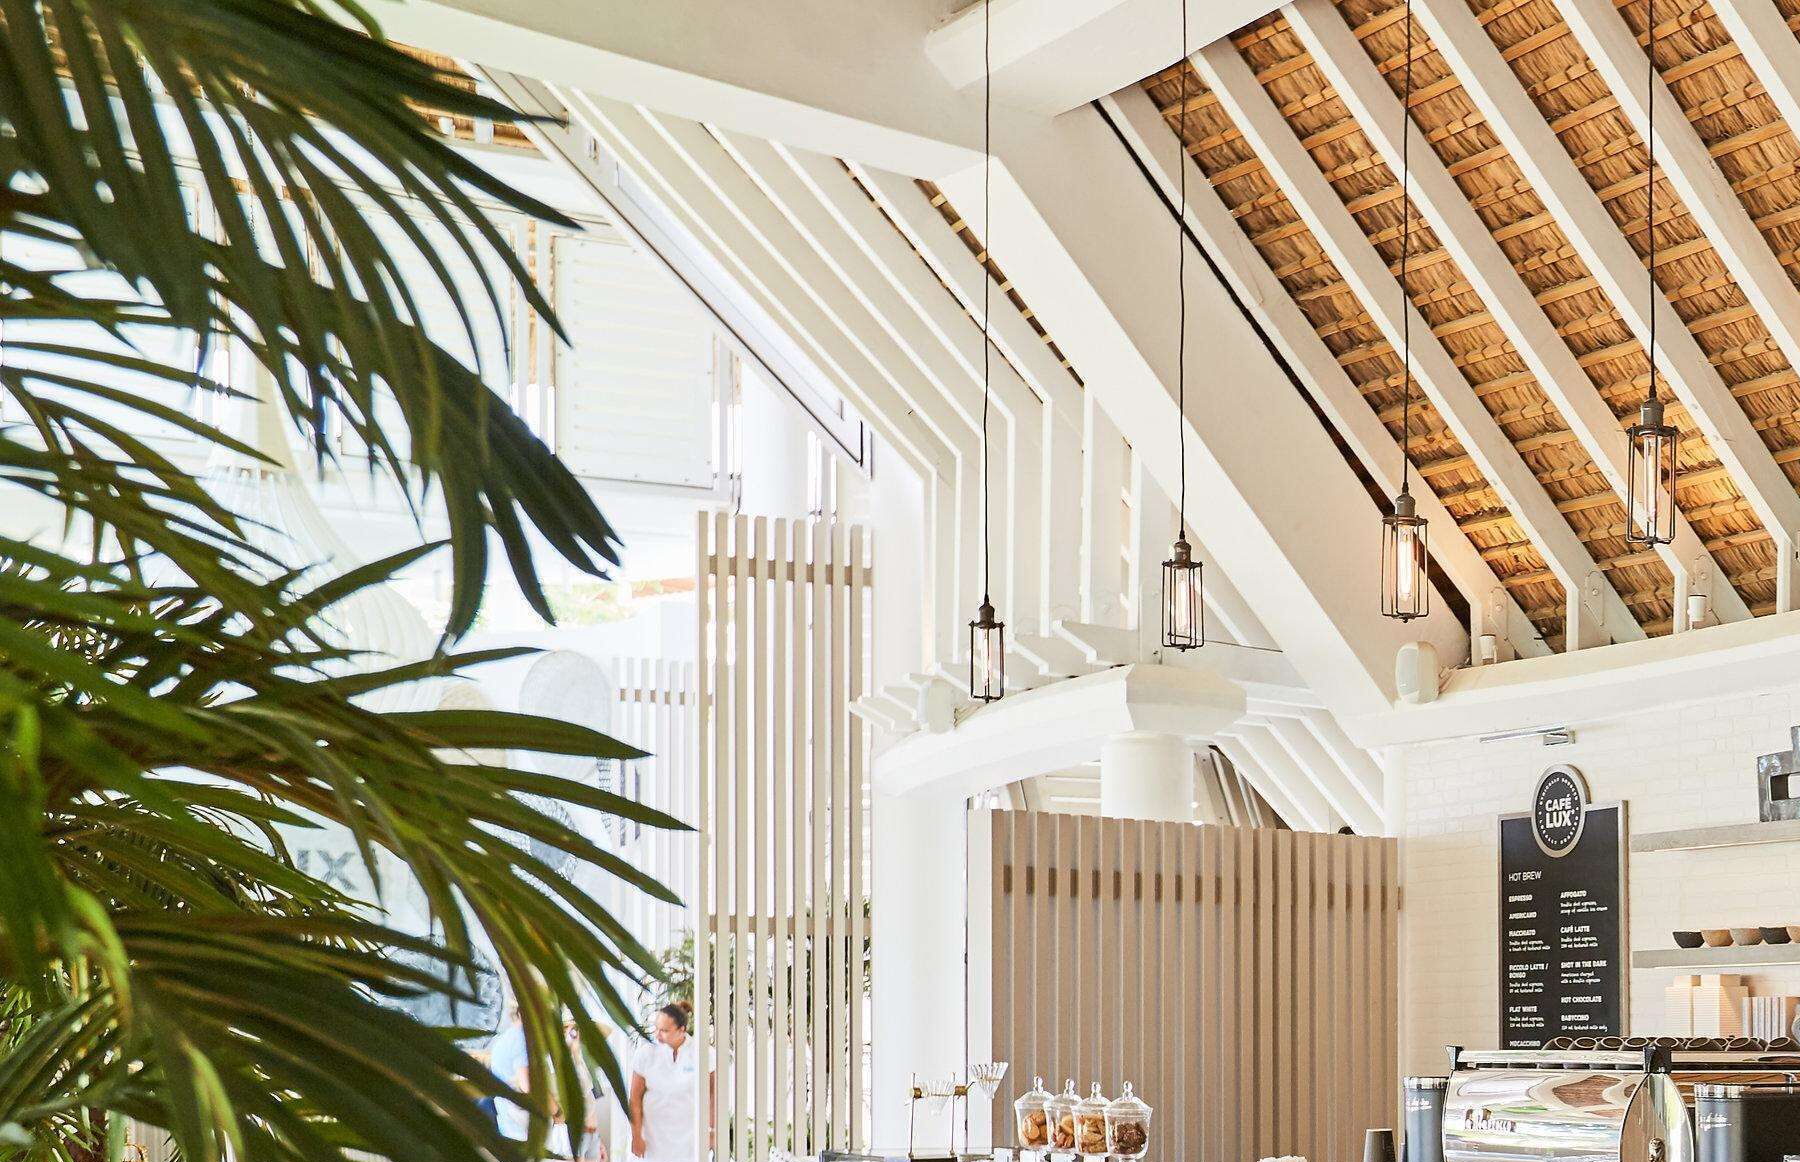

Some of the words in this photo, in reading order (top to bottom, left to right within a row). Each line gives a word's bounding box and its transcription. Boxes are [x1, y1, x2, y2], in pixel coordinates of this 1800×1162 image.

[1545, 793, 1571, 812] CAFÉ
[1508, 872, 1522, 882] HOT
[1522, 870, 1542, 881] BREW
[1508, 894, 1533, 903] ESPRESSO
[1508, 911, 1537, 920] AMERICANO
[1508, 929, 1536, 938] MACCHIATO
[1560, 925, 1574, 934] CAFÉ
[1574, 925, 1590, 933] LATTE
[1530, 963, 1545, 971] LATTE
[1560, 961, 1575, 969] SHOT
[1582, 960, 1592, 968] THE
[1592, 960, 1607, 968] DARK
[1560, 996, 1572, 1004] HOT
[1572, 995, 1602, 1004] CHOCOLATE
